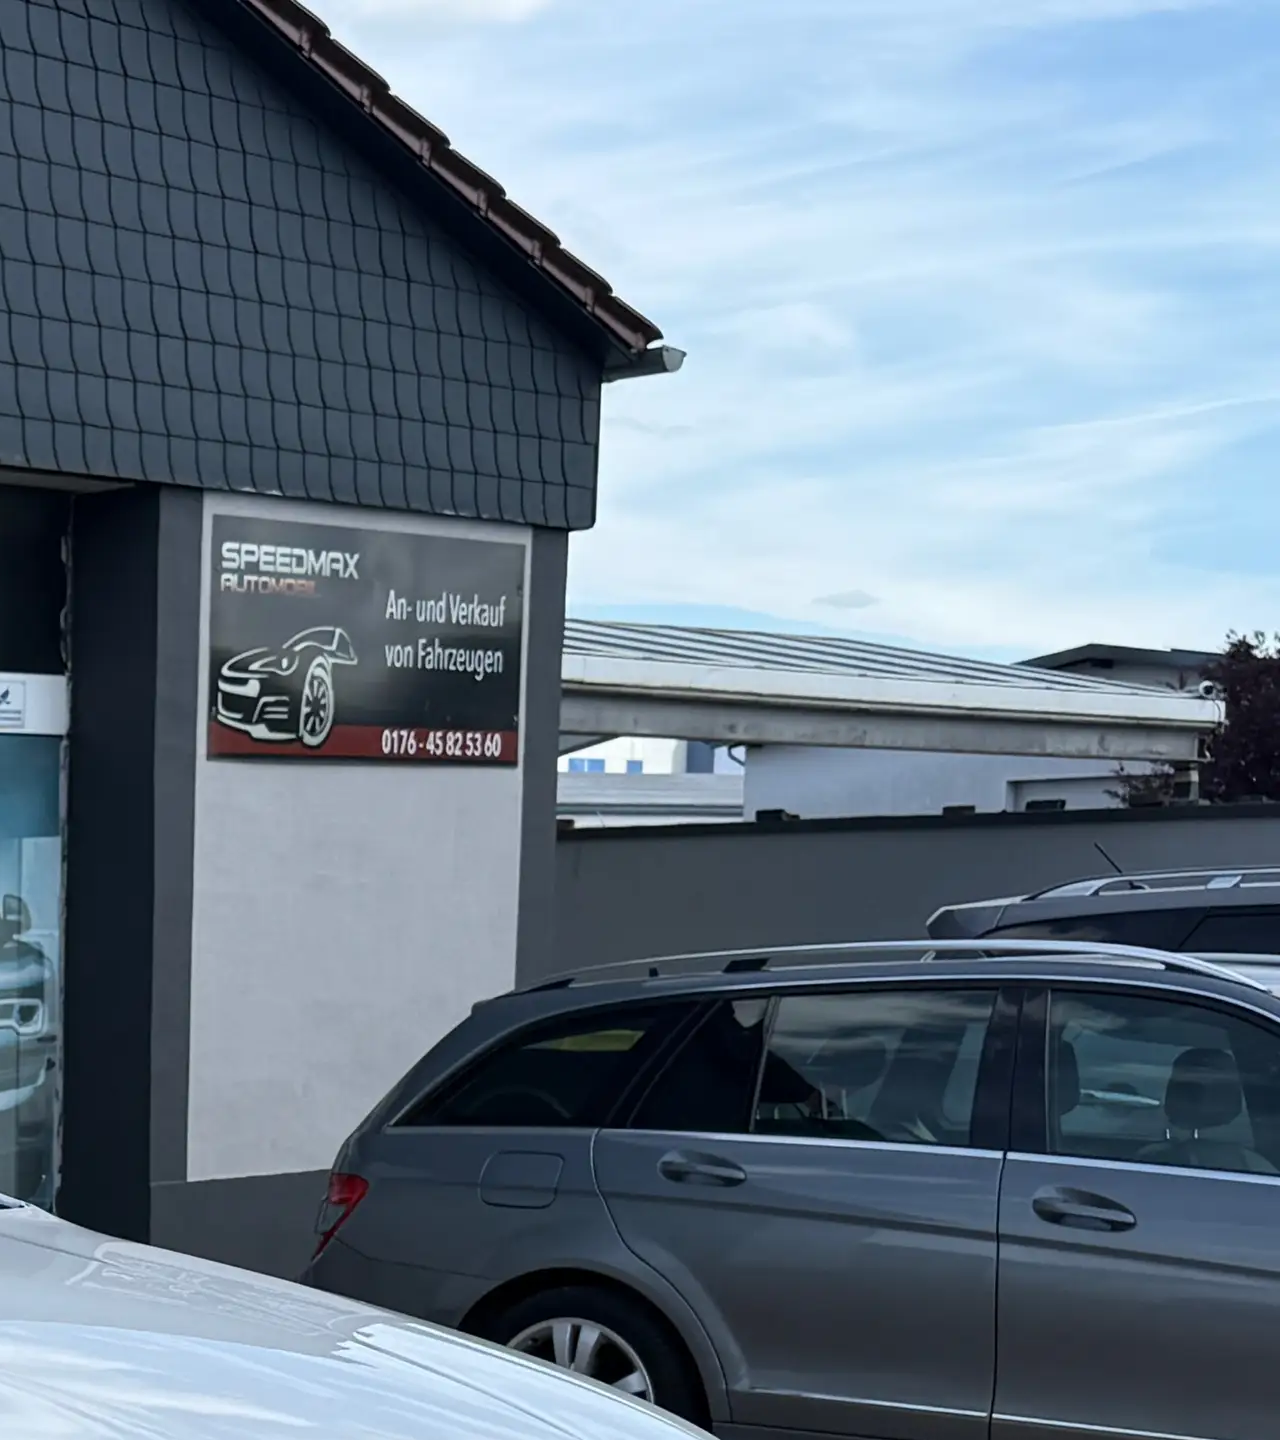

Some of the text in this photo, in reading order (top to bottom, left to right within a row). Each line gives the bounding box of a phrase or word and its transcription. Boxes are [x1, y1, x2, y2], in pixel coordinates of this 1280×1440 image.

[221, 541, 360, 580] SPEEDMAX
[385, 588, 506, 627] An- und Verkauf
[385, 638, 503, 681] von Fahrzeugen
[382, 729, 417, 756] 0176
